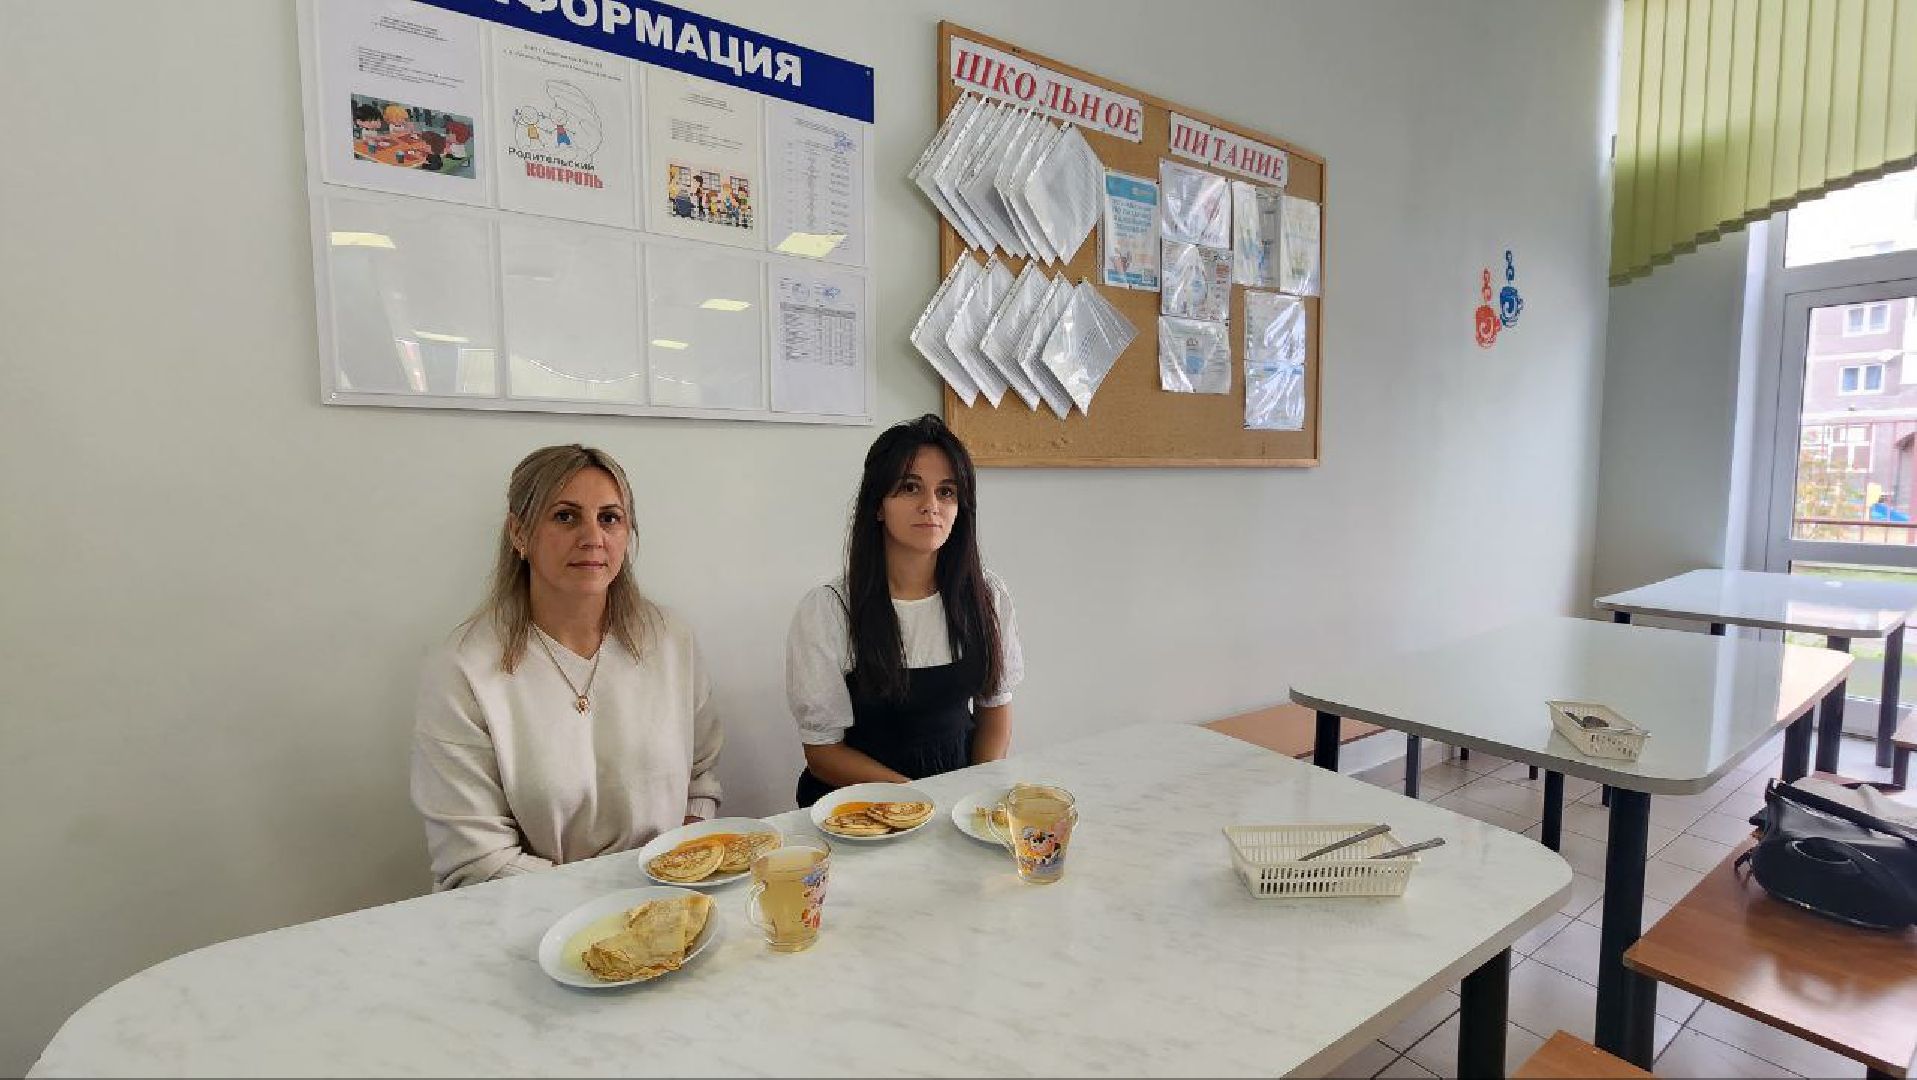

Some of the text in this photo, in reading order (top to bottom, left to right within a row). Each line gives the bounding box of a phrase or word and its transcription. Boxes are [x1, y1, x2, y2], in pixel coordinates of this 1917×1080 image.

[494, 0, 803, 87] ОРМАЦИЯ
[954, 49, 1285, 181] ШКОЛЬНОЕ ПИТАНИЕ
[508, 147, 595, 171] Родительский
[525, 162, 604, 189] КОНТРОЛЬ
